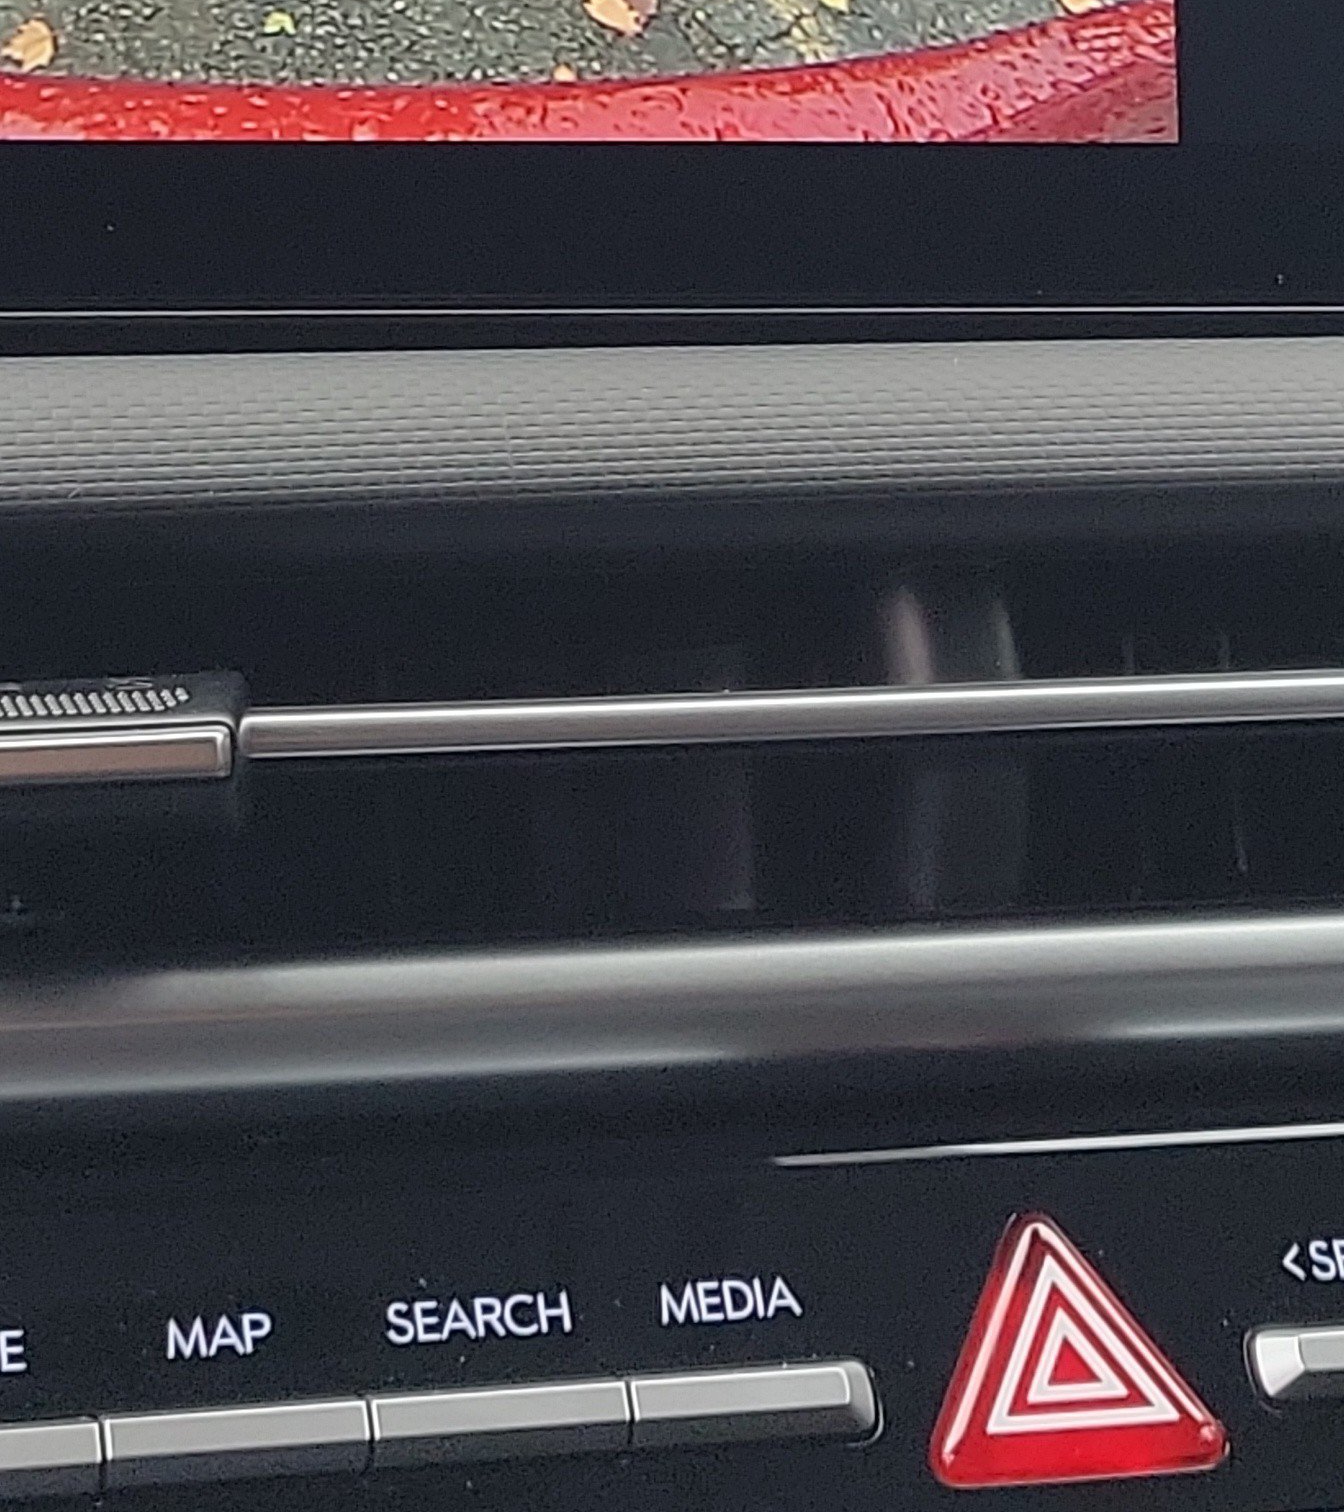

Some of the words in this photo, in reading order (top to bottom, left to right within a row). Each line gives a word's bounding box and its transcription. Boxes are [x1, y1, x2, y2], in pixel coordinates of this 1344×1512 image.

[385, 1290, 574, 1346] SEARCH
[659, 1276, 803, 1327] MEDIA
[166, 1312, 274, 1361] MAP
